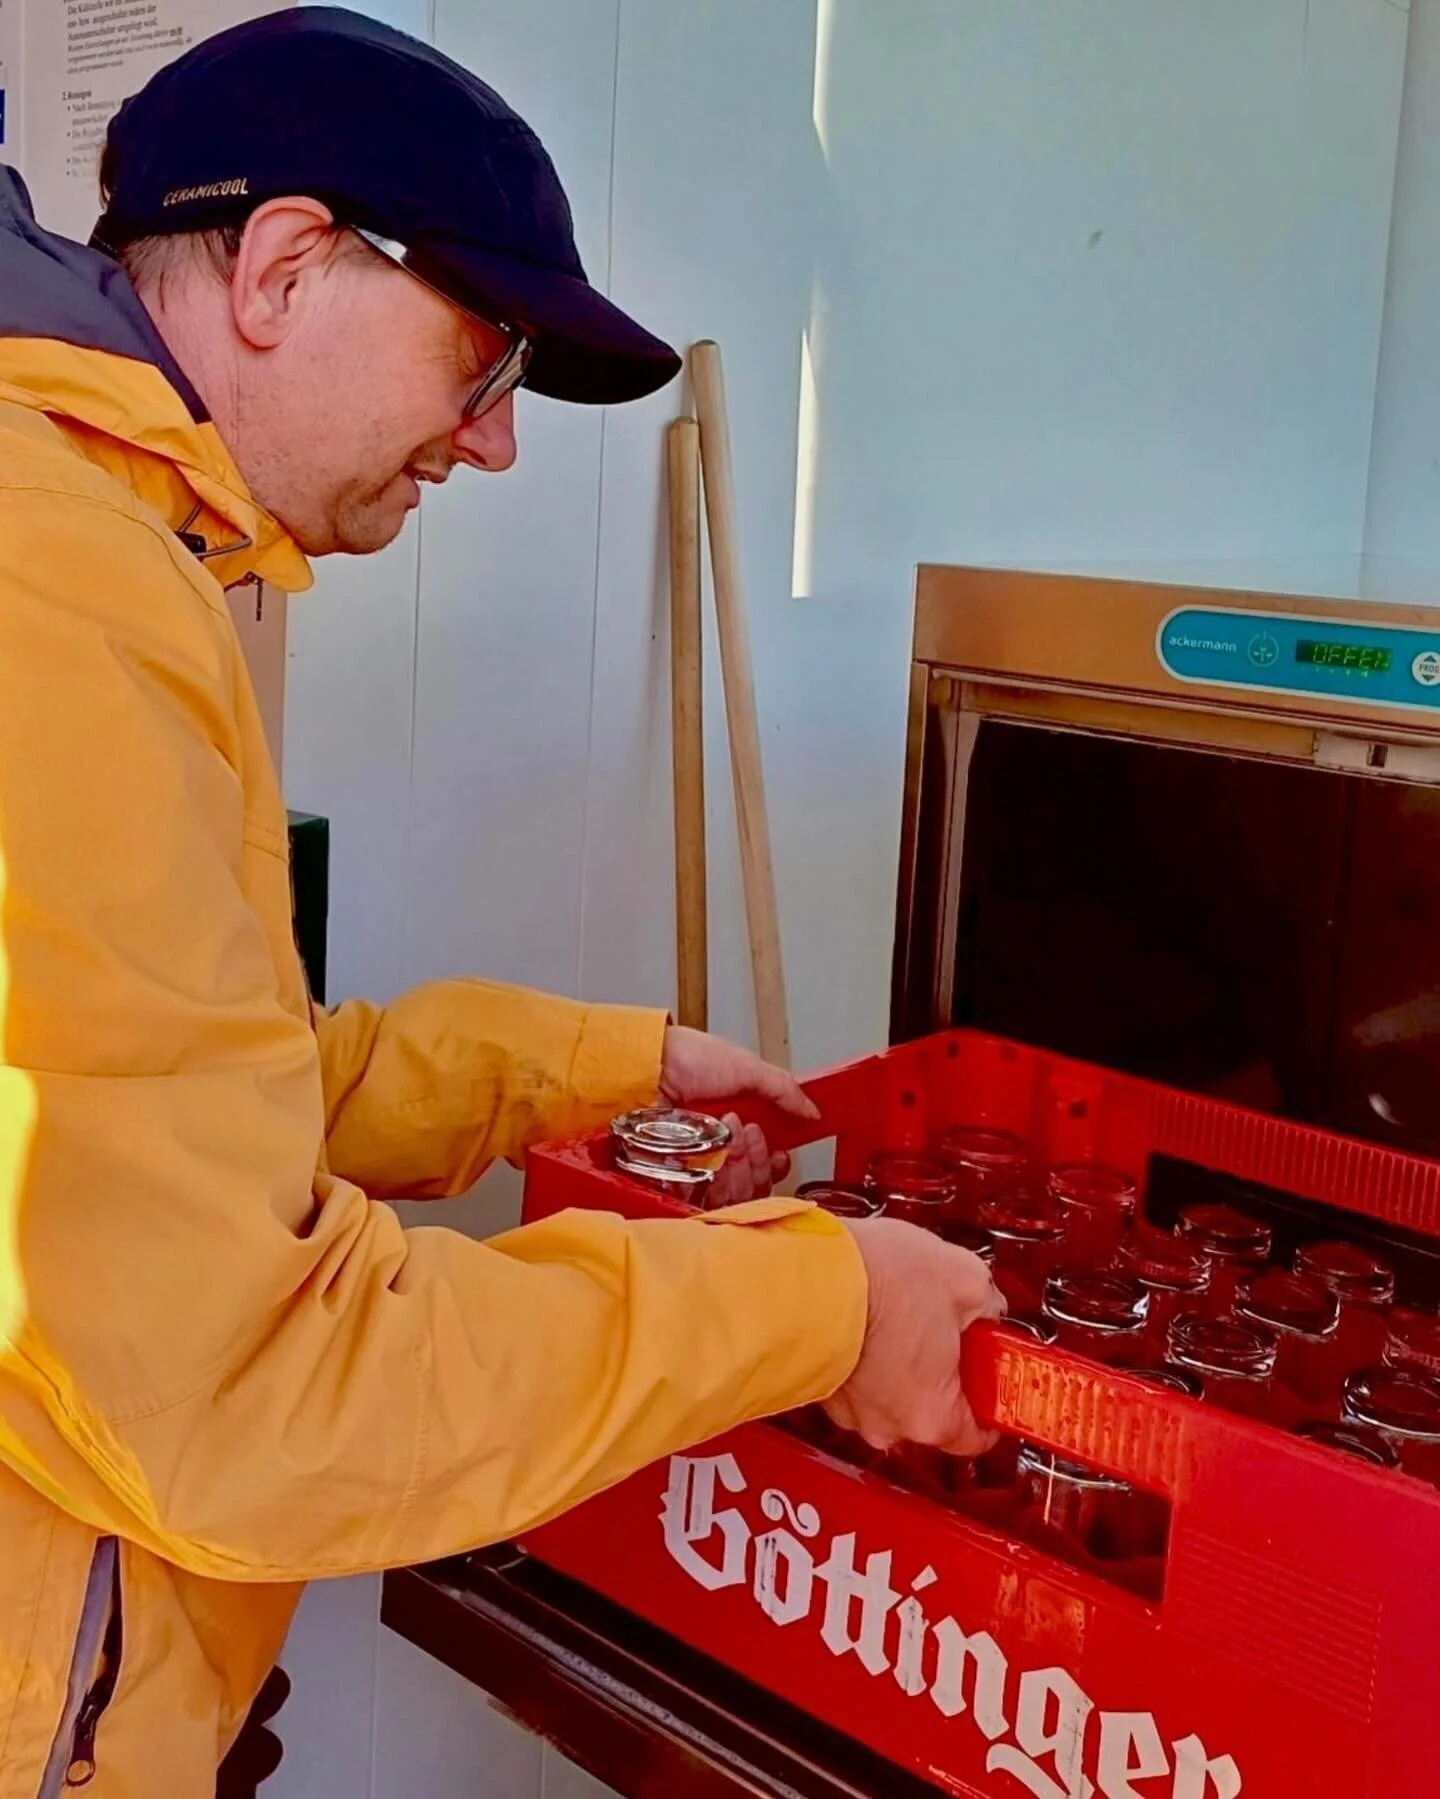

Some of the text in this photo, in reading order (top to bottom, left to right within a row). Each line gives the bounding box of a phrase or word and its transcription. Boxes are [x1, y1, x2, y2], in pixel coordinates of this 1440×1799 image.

[163, 177, 248, 207] CERAMICOOL
[1168, 635, 1237, 653] ackermann
[658, 1452, 1242, 1799] Göttinger
